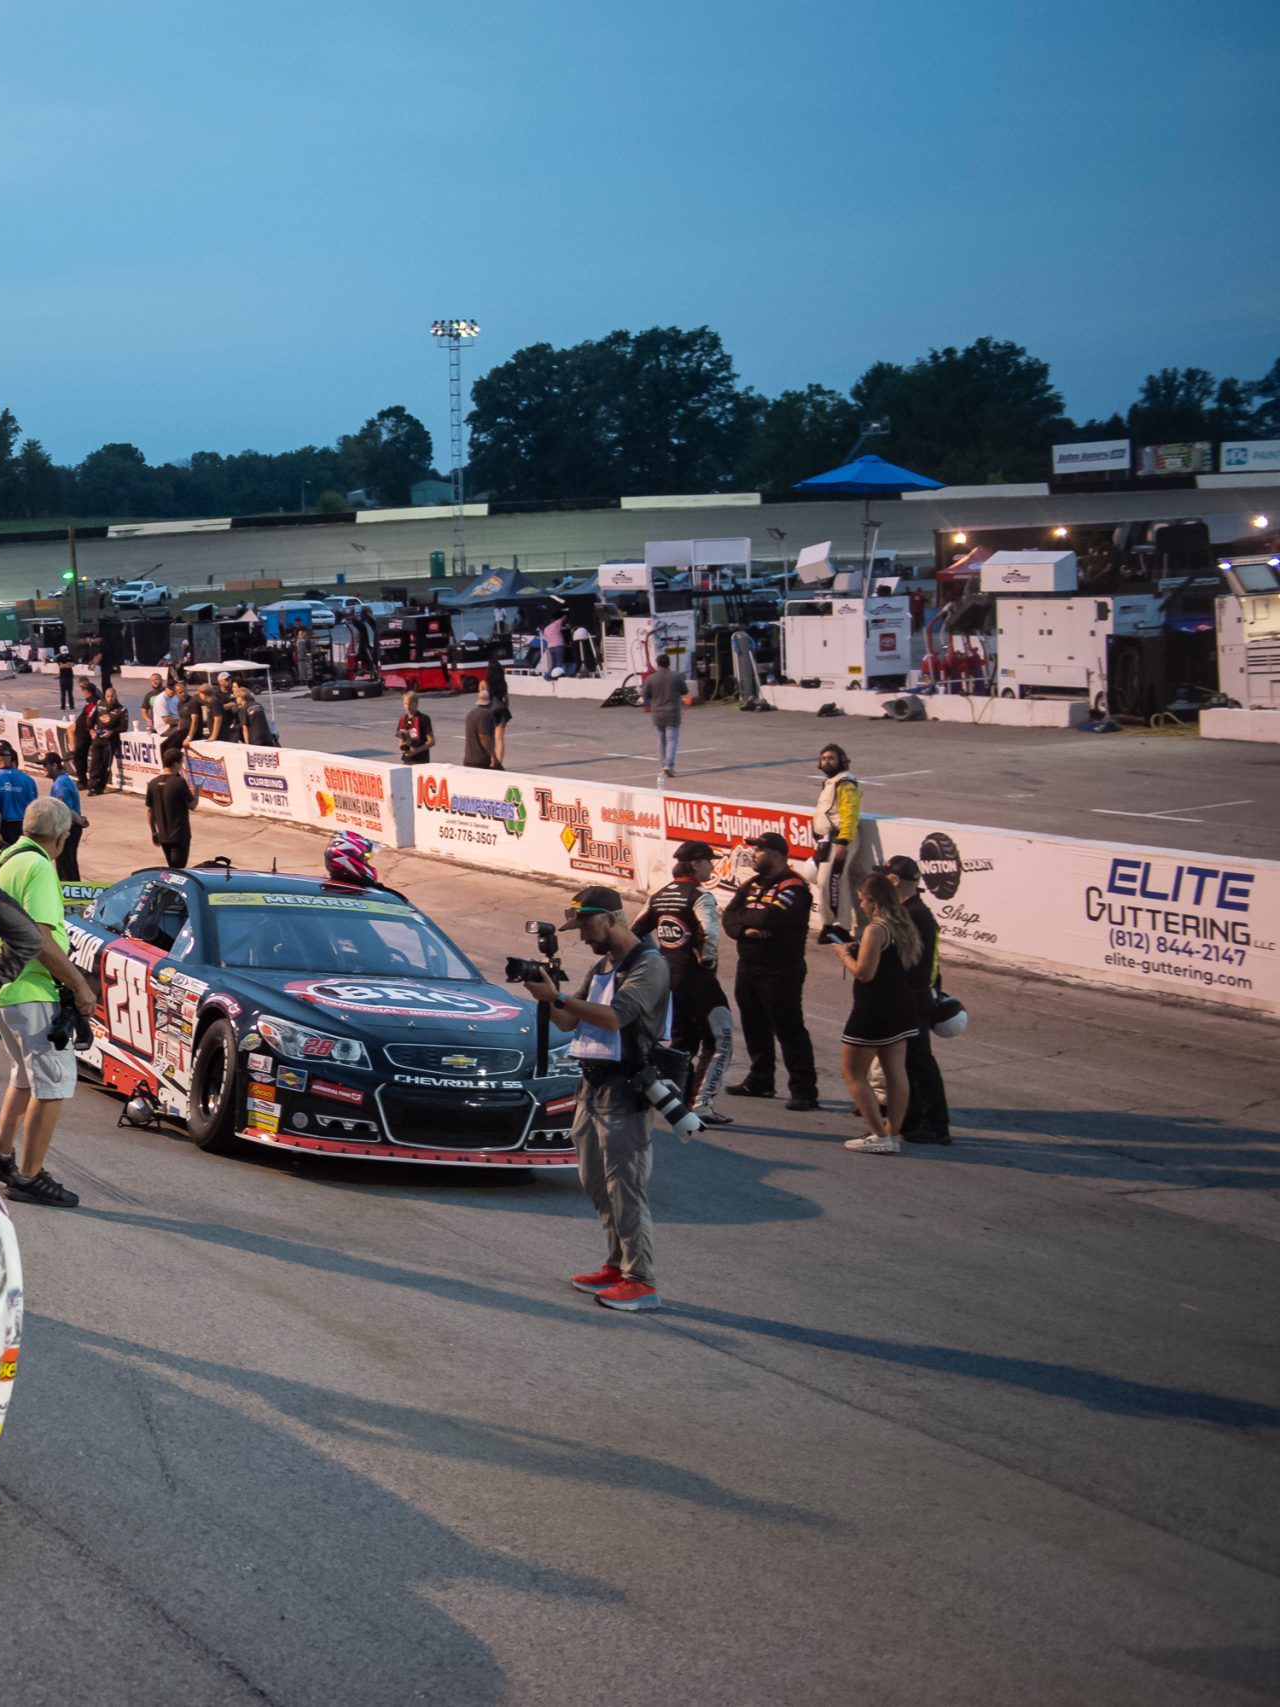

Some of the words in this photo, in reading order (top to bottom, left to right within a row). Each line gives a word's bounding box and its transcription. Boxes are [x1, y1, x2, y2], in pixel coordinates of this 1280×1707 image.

[247, 776, 284, 790] CURBING
[324, 766, 384, 800] SCOTTSBURG
[417, 774, 450, 813] ICA
[450, 793, 517, 823] DUMPSTERS
[533, 787, 590, 828] Temple
[665, 800, 711, 832] WALLS
[713, 806, 786, 842] Equipment
[789, 816, 817, 848] Sal
[438, 825, 498, 847] 502-776-3507
[573, 825, 632, 867] Temple
[62, 885, 105, 899] MENA
[263, 895, 368, 909] MENARDS
[1107, 858, 1255, 912] ELITE
[657, 925, 682, 938] BRC
[937, 904, 981, 927] Shop
[1086, 886, 1251, 947] GUTTERING
[1253, 939, 1277, 951] LLC
[1109, 928, 1151, 954] (812)
[1156, 936, 1246, 967] 844-2147
[1105, 952, 1253, 990] elite-guttering.com
[104, 950, 153, 1056] 28
[324, 985, 479, 1008] BRC
[302, 1037, 336, 1057] 28
[393, 1074, 498, 1089] CHEVROLET
[502, 1080, 523, 1089] SS
